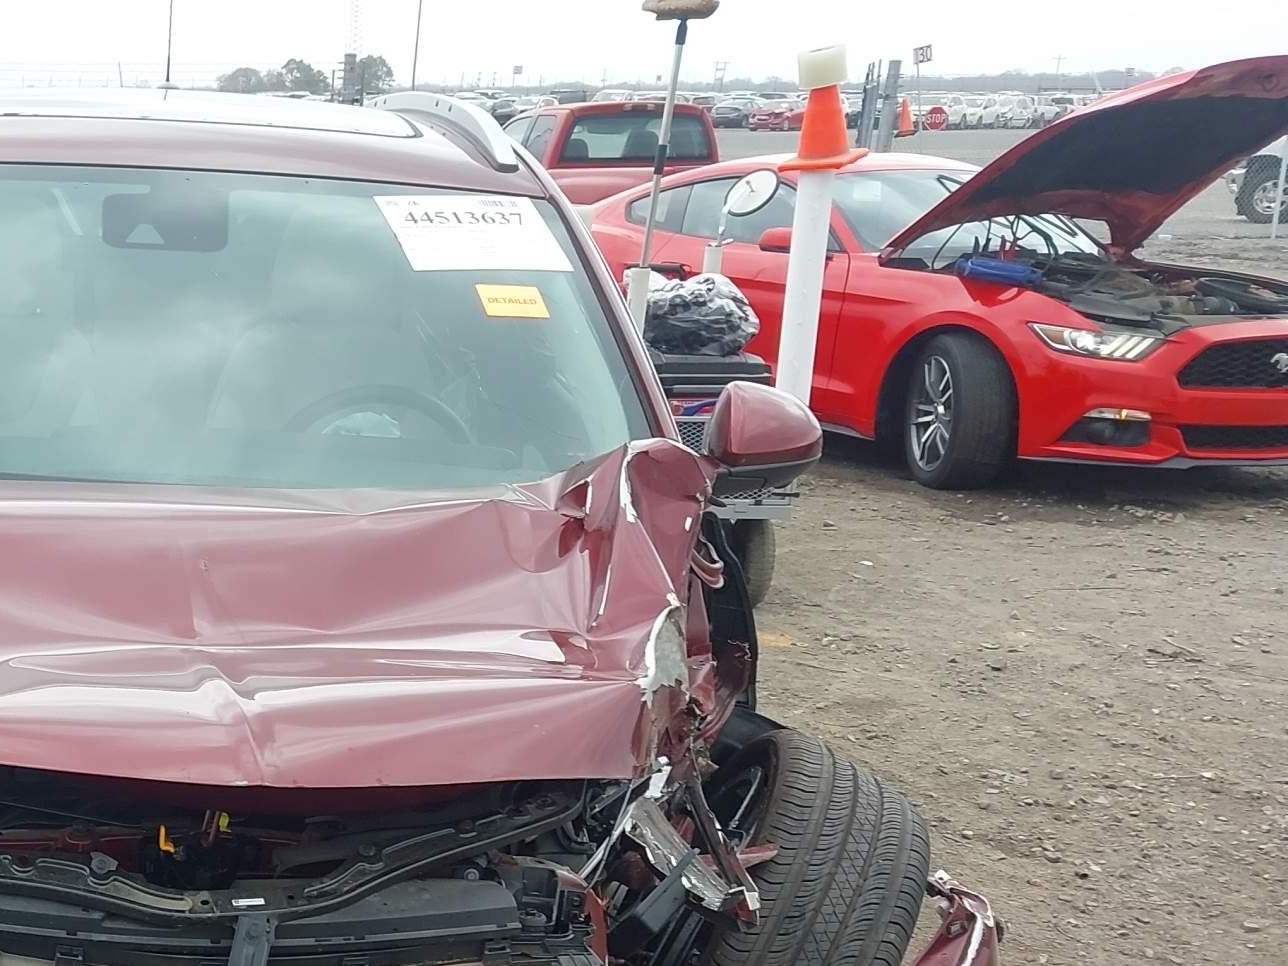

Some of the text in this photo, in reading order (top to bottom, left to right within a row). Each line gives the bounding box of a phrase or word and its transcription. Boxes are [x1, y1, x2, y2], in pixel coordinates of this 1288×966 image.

[919, 46, 932, 63] 30
[926, 114, 946, 123] STOP
[404, 211, 522, 226] 44513637
[487, 297, 537, 305] DETAILED
